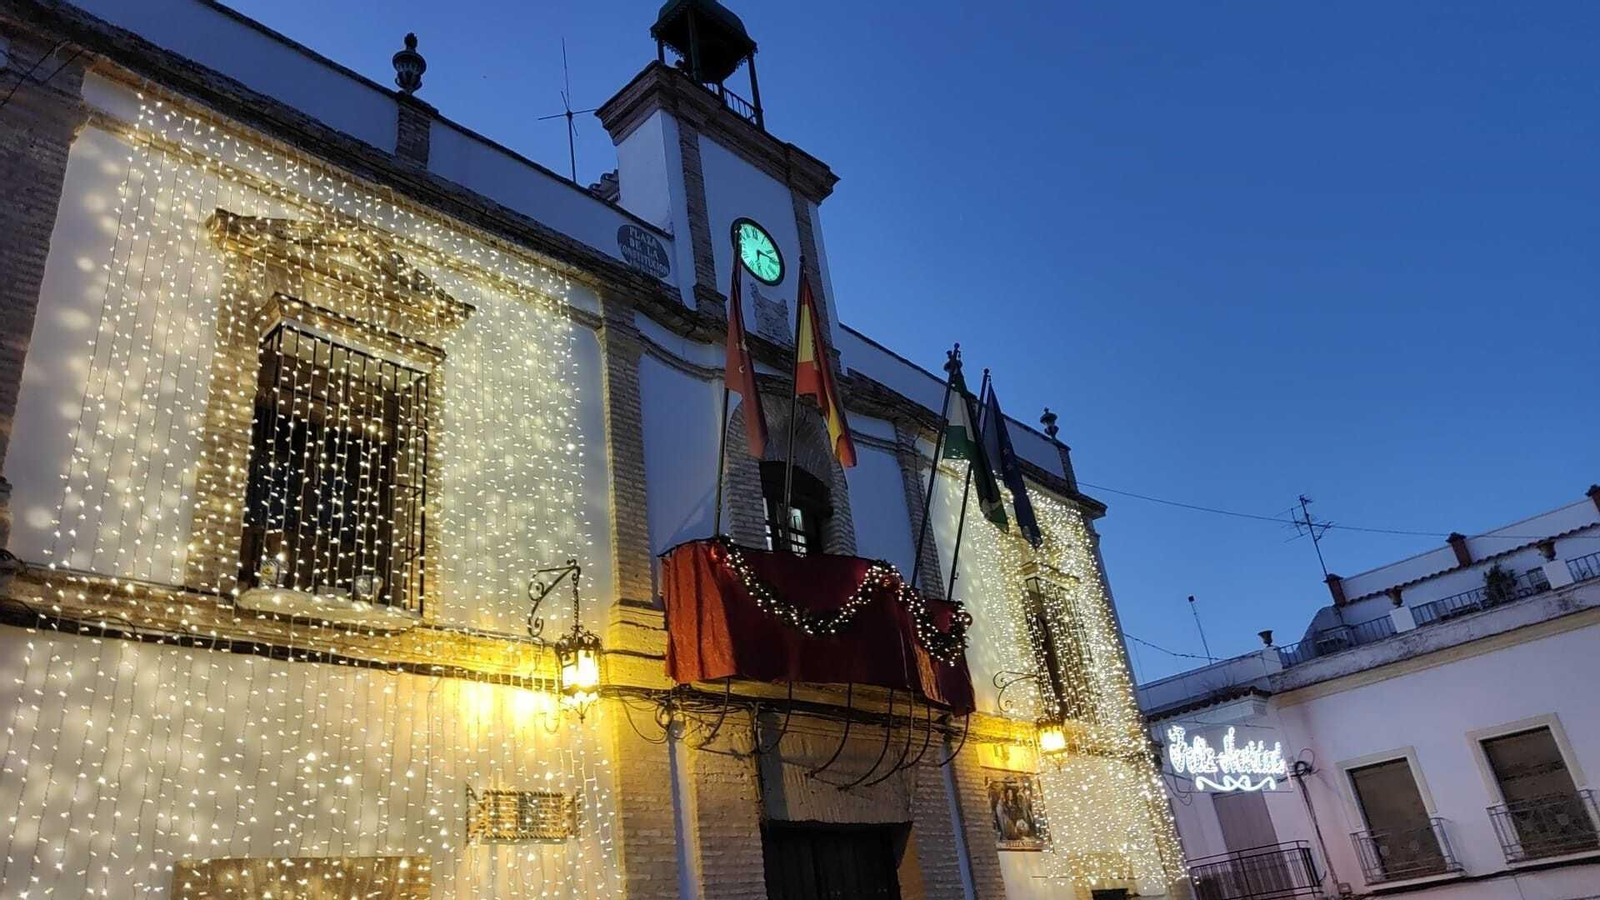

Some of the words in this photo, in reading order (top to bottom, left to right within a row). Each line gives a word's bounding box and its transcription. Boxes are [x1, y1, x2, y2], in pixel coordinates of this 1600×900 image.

[629, 226, 658, 249] PLAZA
[629, 237, 642, 251] DE
[646, 246, 659, 260] LA
